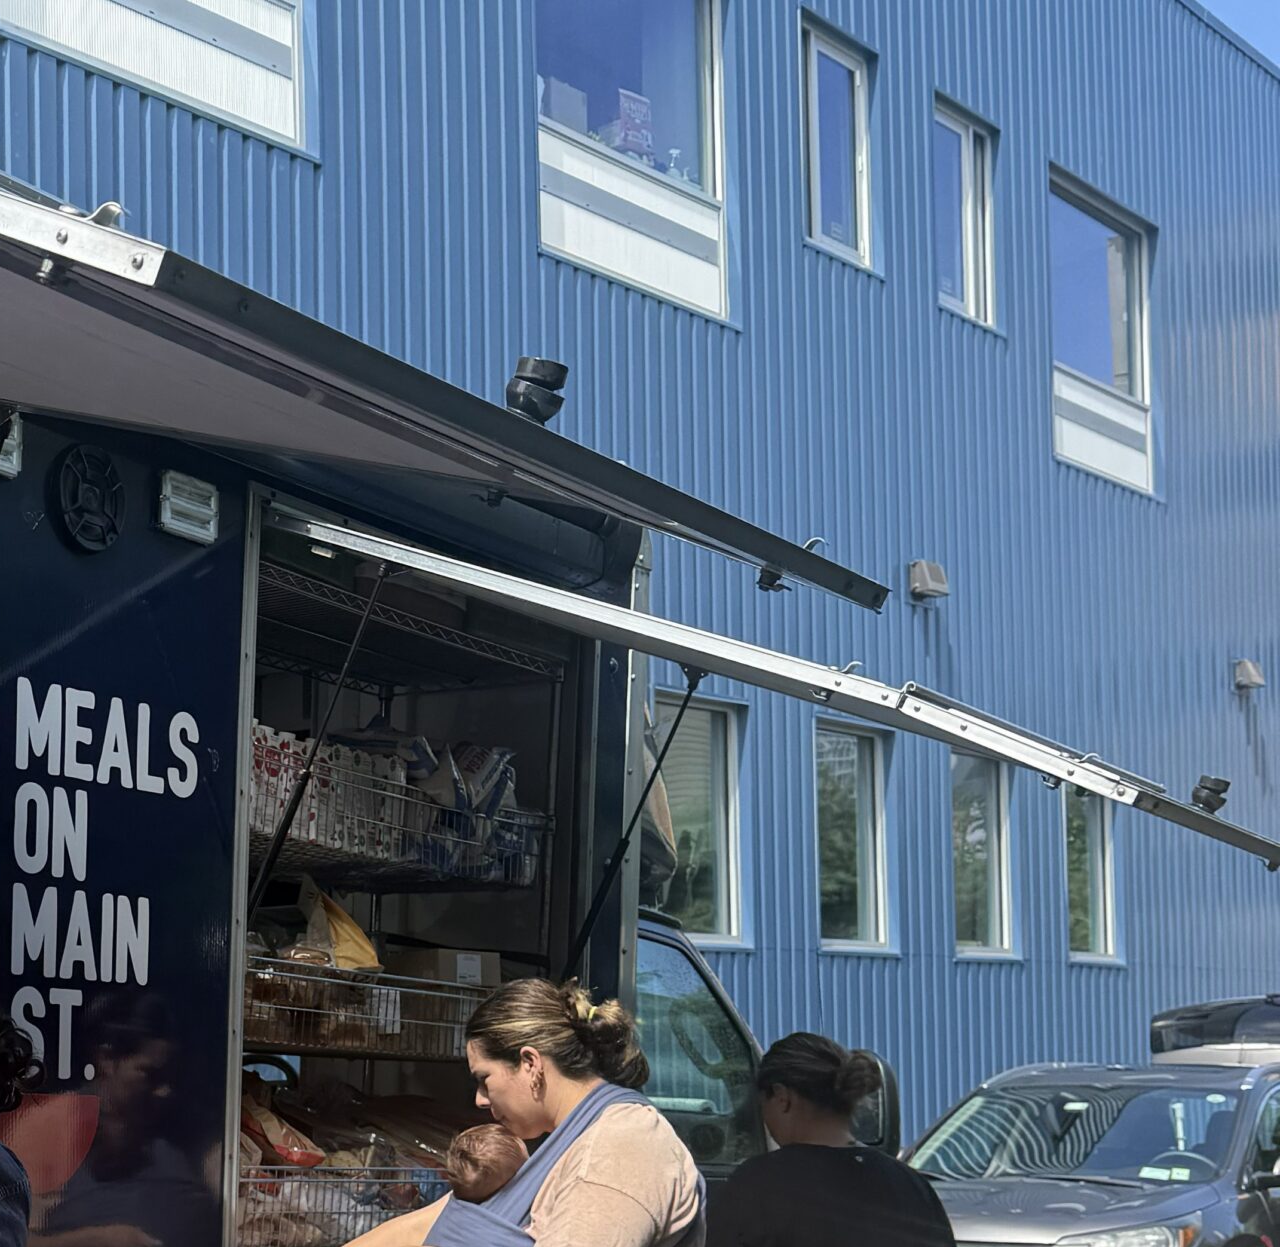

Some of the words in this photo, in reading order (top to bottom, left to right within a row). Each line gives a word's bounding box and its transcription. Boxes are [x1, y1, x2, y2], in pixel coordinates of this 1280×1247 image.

[14, 676, 200, 799] MEALS
[13, 782, 89, 882] ON
[11, 882, 150, 986] MAIN
[10, 987, 96, 1081] ST.
